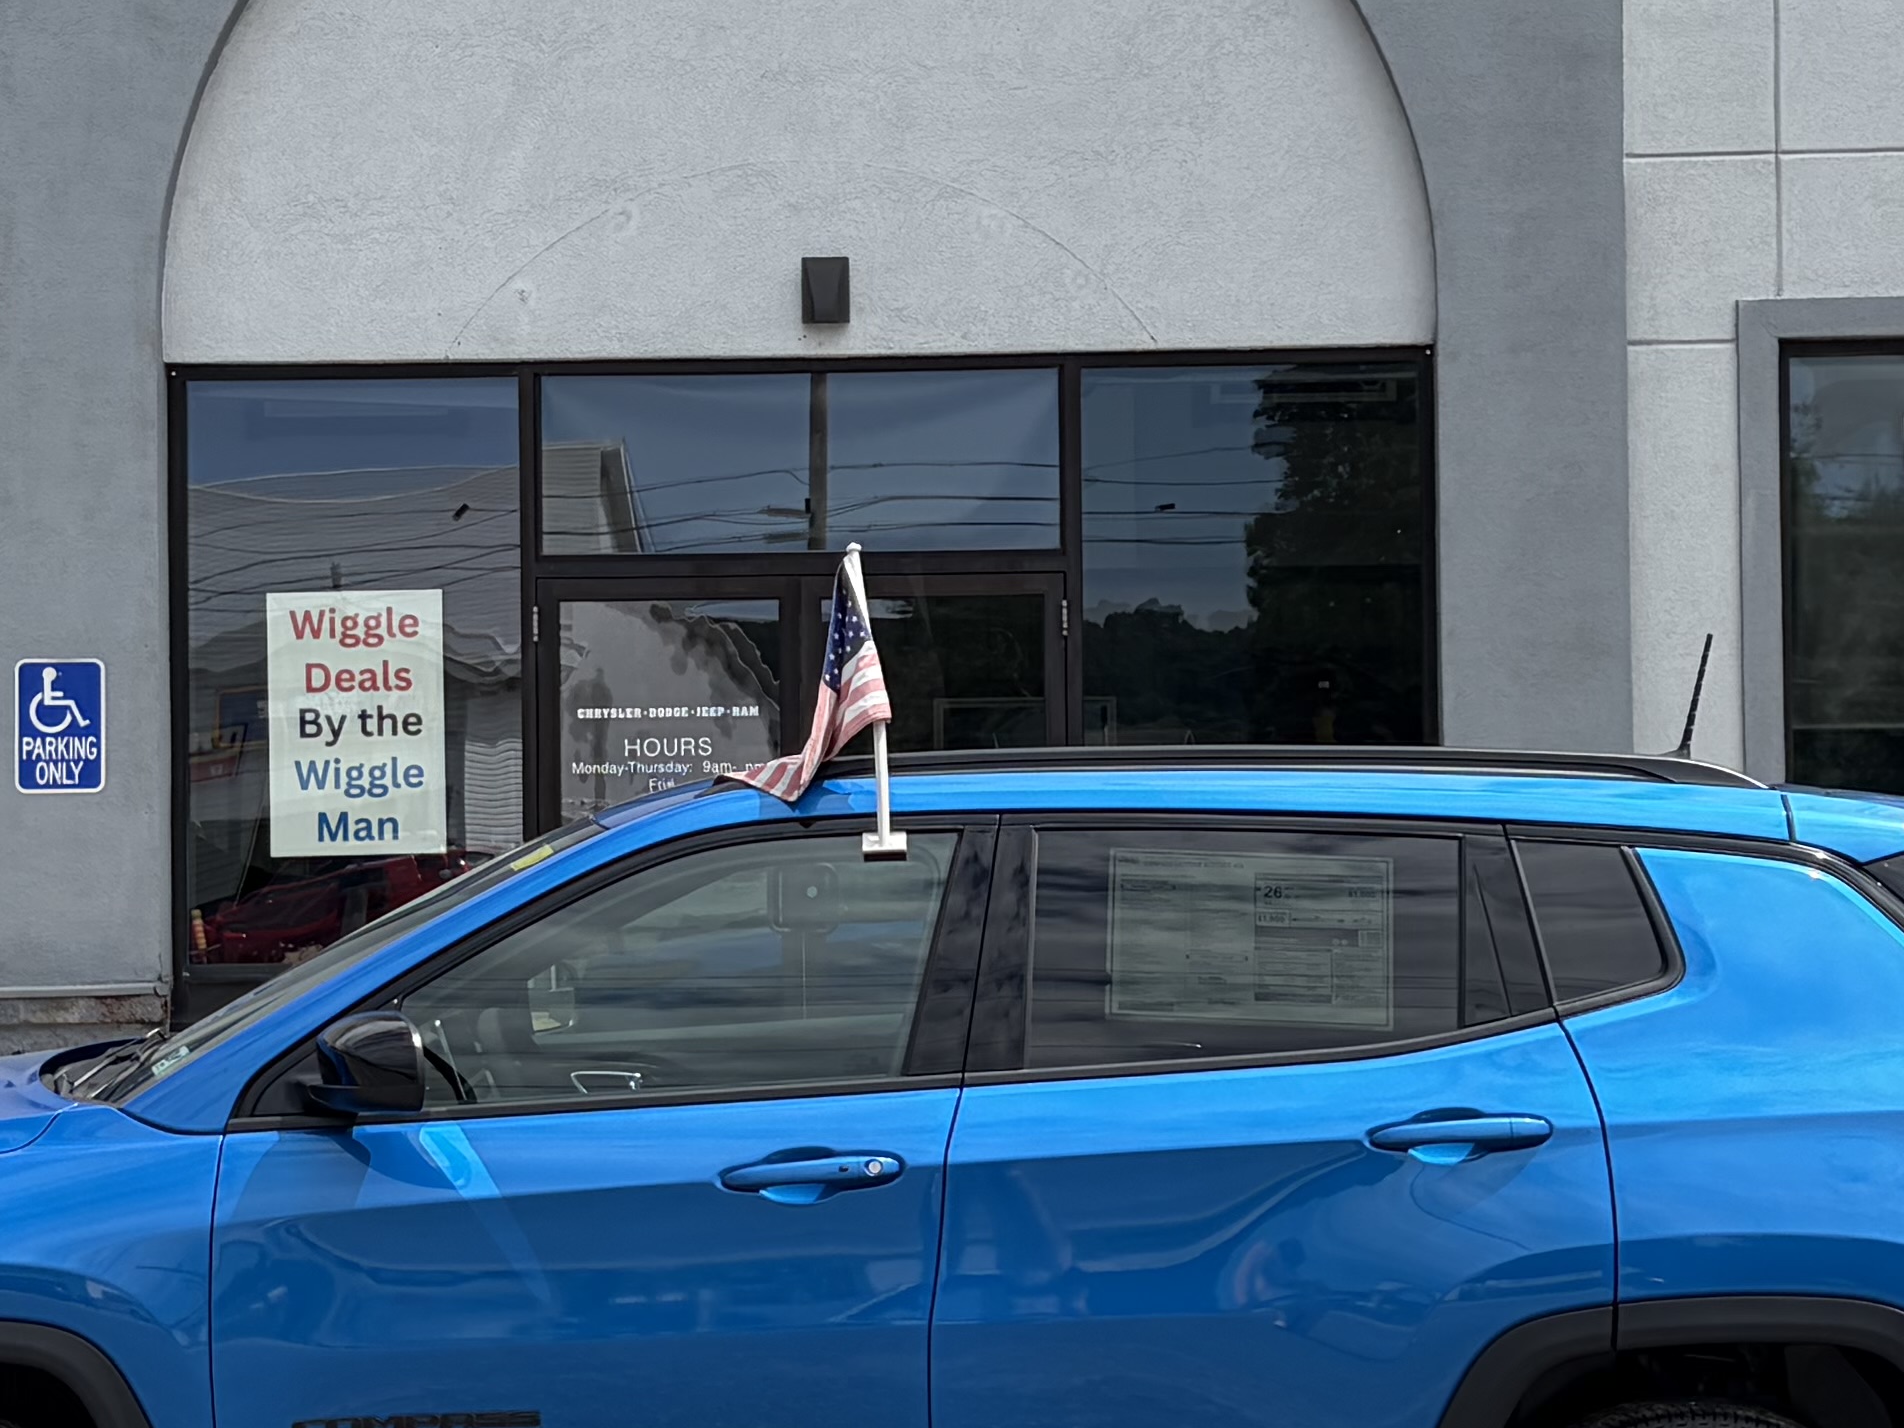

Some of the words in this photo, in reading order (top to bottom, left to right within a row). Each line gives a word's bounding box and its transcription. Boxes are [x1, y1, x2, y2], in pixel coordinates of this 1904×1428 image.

[289, 606, 420, 648] Wiggle
[305, 659, 413, 693] Deals
[299, 708, 347, 747] By
[357, 705, 423, 737] the
[577, 707, 642, 719] CHRYSLER
[649, 707, 689, 718] DODGE
[732, 705, 760, 717] RAM
[22, 736, 98, 760] PARKING
[624, 737, 712, 757] HOURS
[36, 761, 84, 785] ONLY
[294, 756, 425, 799] Wiggle
[317, 811, 399, 842] Man
